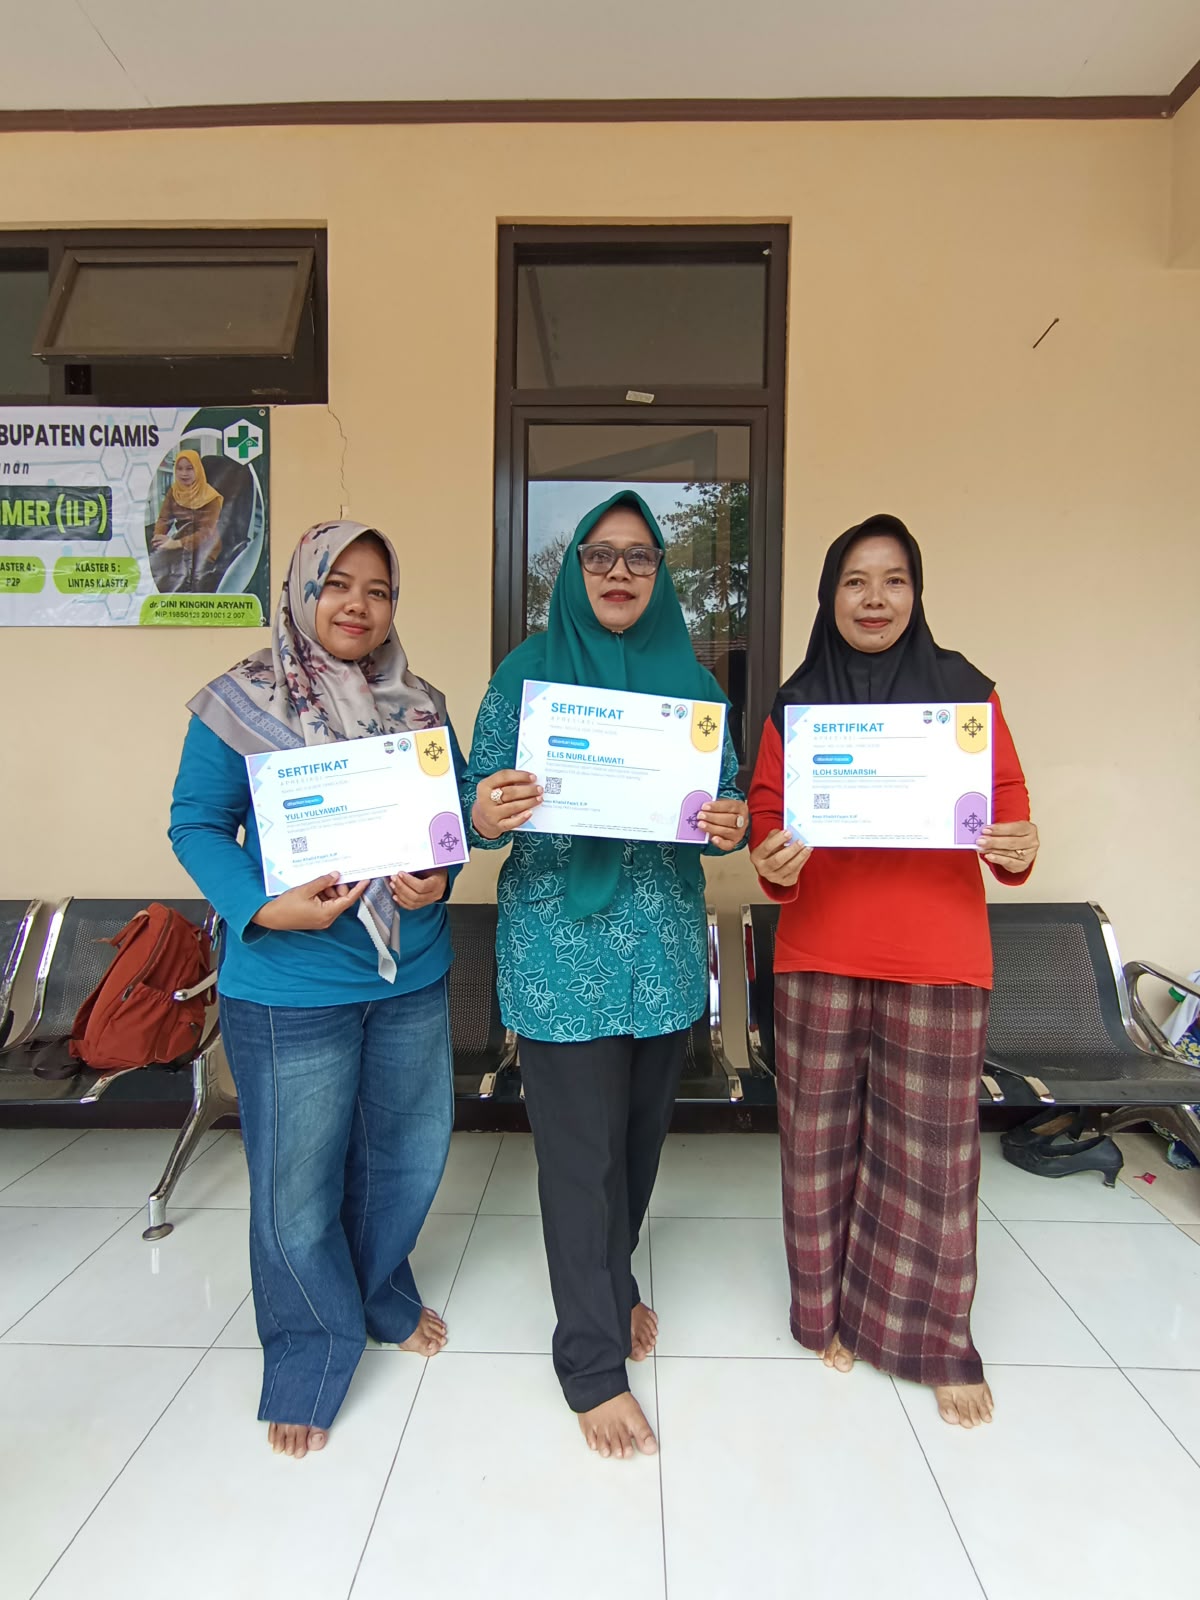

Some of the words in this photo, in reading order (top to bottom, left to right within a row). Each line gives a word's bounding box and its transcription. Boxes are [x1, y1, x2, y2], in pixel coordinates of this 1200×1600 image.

[89, 424, 159, 447] CIAMIS
[0, 462, 29, 474] nan
[0, 499, 50, 526] MER
[55, 493, 108, 534] (ILP)
[75, 562, 110, 572] KLASTER
[6, 577, 21, 587] P2P
[68, 578, 95, 588] LINTAS
[96, 578, 129, 588] KLASTER
[149, 601, 159, 609] dr.
[160, 600, 178, 608] DINI
[180, 601, 215, 609] KINGKIN
[216, 601, 253, 610] ARYANTI
[551, 702, 625, 721] SERTIFIKAT
[813, 722, 885, 733] SERTIFIKAT
[547, 750, 565, 760] ELIS
[565, 751, 625, 765] NURLELIAWATI
[277, 759, 349, 779] SERTIFIKAT
[285, 812, 304, 822] YULI
[304, 805, 348, 819] YULYAWATI
